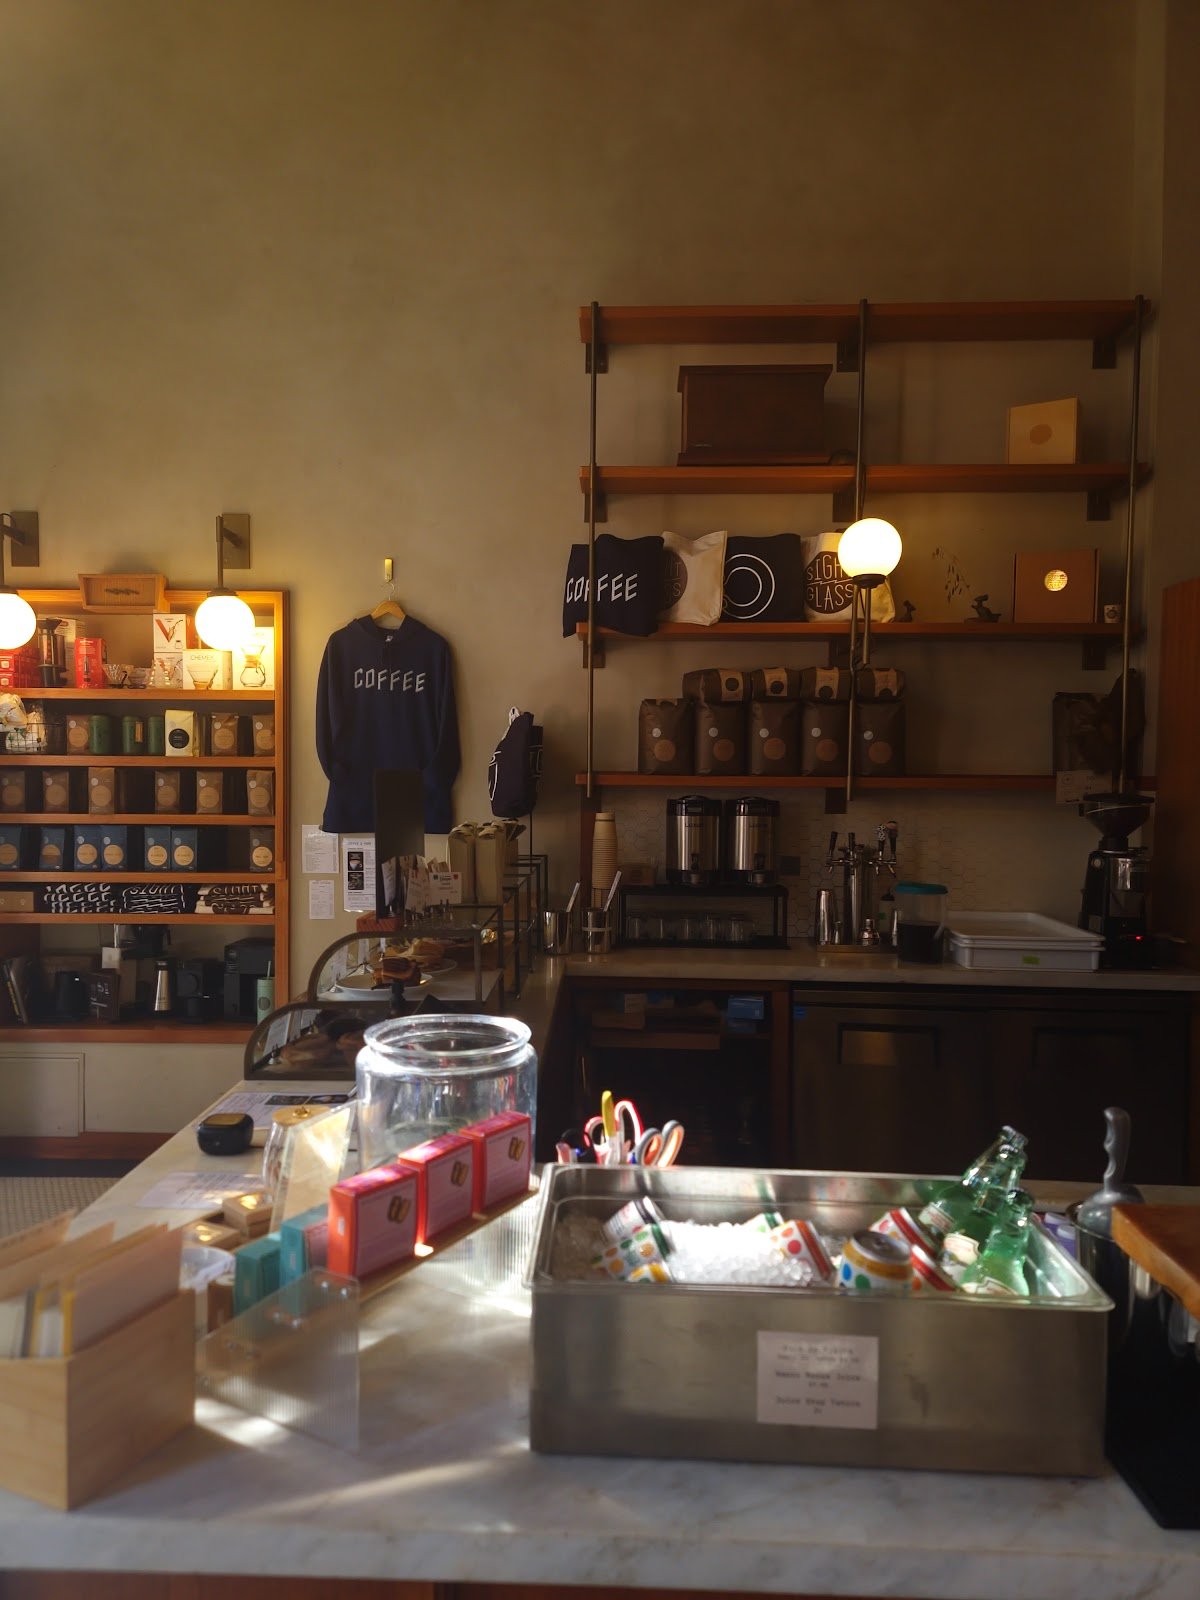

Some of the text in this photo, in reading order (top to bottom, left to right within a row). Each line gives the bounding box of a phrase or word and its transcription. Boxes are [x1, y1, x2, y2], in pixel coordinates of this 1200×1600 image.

[807, 554, 844, 581] SIGH
[566, 573, 638, 603] COFFEE
[807, 583, 854, 611] GLASS
[354, 667, 426, 693] COFFEE
